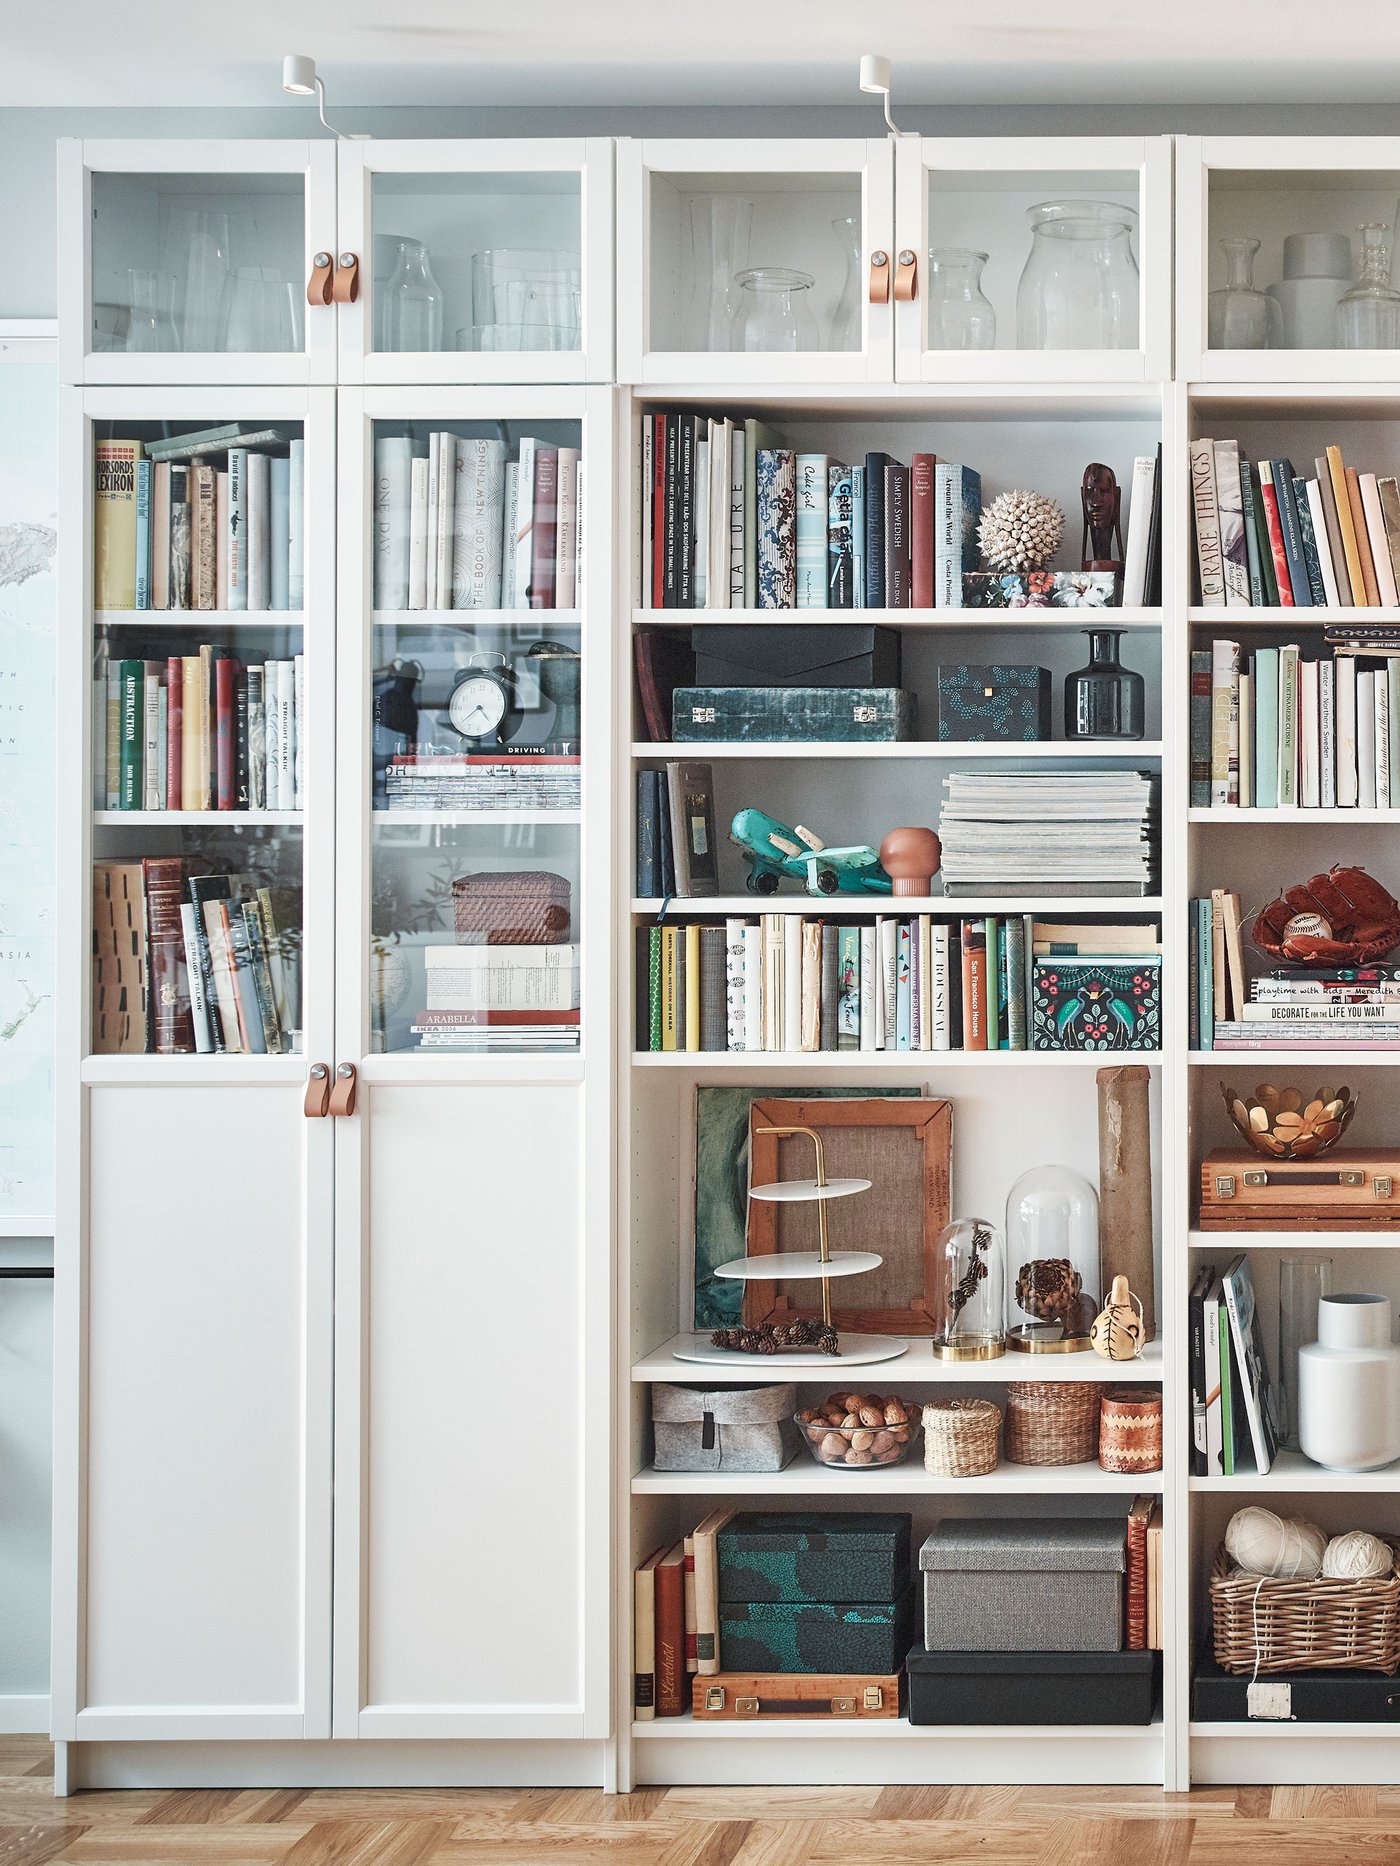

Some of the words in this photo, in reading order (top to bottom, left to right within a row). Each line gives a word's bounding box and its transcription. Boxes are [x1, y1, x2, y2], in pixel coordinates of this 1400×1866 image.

[476, 440, 488, 486] THINGS
[511, 465, 519, 488] Winter
[804, 466, 816, 488] Cake
[96, 474, 135, 492] LEXIKON
[231, 476, 239, 502] Baldacci
[379, 478, 392, 514] ONE
[853, 472, 861, 497] France
[894, 476, 902, 507] SIMPLY
[945, 477, 953, 506] Around
[1192, 452, 1215, 520] THINGS
[1278, 462, 1286, 483] WILLIAM
[1282, 483, 1291, 508] WHARTON
[1287, 511, 1295, 532] MÅNENS
[475, 489, 486, 517] NEW
[561, 494, 569, 519] KAGAN
[801, 491, 816, 509] girl
[867, 484, 883, 530] Heights
[945, 507, 953, 520] the
[510, 499, 518, 531] Northern
[894, 509, 902, 548] SWEDISH
[379, 522, 392, 556] DAY
[475, 528, 485, 544] OF
[508, 532, 517, 560] Sweden
[731, 484, 743, 594] NATURE
[944, 521, 953, 545] World
[474, 547, 485, 578] BOOK
[682, 533, 690, 570] SKOFÖRVARING
[867, 534, 883, 596] Wuthering
[1200, 530, 1221, 577] RARE
[944, 559, 953, 578] Costa
[473, 583, 484, 606] THE
[943, 580, 953, 606] Printing
[125, 675, 136, 741] ABSTRACTION
[1379, 688, 1388, 712] opera
[281, 701, 289, 739] STRAIGHT
[1378, 713, 1387, 725] the
[1379, 726, 1388, 735] of
[1213, 695, 1231, 774] STYLED
[281, 742, 289, 772] TALKIN'
[1379, 736, 1388, 781] Phantom
[126, 780, 134, 802] BURNS
[1379, 783, 1388, 802] The
[1294, 916, 1317, 924] Wilson
[190, 942, 199, 981] STRAIGHT
[886, 956, 897, 991] Heights
[971, 960, 979, 975] San
[194, 983, 203, 1013] TALKIN'
[844, 984, 855, 1002] Lisa
[971, 977, 979, 1010] Francisco
[1258, 987, 1297, 997] playtime
[426, 1014, 476, 1024] ARABELLA
[667, 1003, 673, 1011] OM
[843, 1003, 855, 1029] Jewell
[884, 993, 897, 1039] Wuthering
[911, 993, 919, 1026] GERMANS
[1271, 1007, 1309, 1018] DECORATE
[1328, 1007, 1345, 1018] LIFE
[1347, 1007, 1362, 1017] YOU
[1364, 1006, 1386, 1017] WANT
[166, 1032, 176, 1041] 15
[971, 1012, 980, 1037] Houses
[660, 1640, 675, 1698] Levebröd
